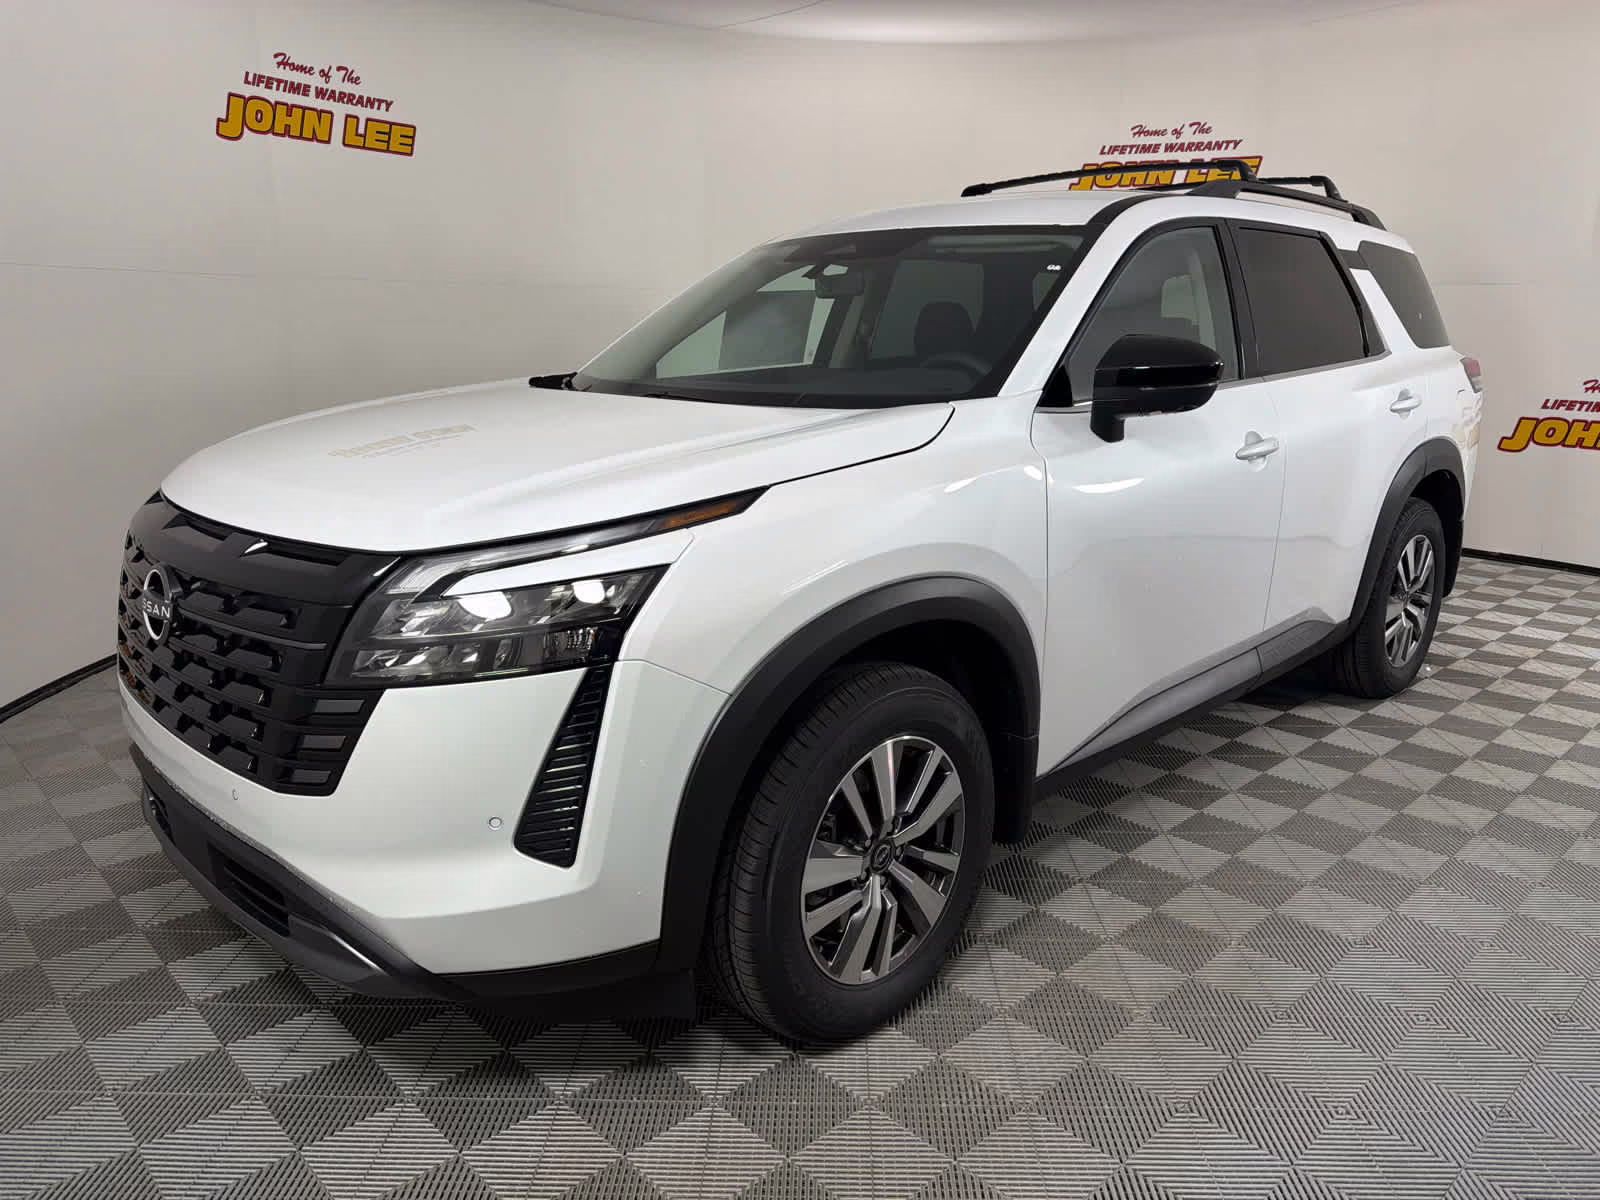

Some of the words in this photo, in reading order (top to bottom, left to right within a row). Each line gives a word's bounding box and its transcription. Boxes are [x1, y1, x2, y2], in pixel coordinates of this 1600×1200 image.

[273, 52, 315, 76] Home
[319, 64, 332, 84] of
[336, 65, 362, 85] The
[243, 71, 312, 97] LIFETIME
[314, 85, 394, 112] WARRANTY
[216, 92, 334, 144] JOHN
[342, 113, 417, 157] LEE
[1130, 124, 1168, 138] Home
[1171, 123, 1185, 139] of
[1188, 121, 1213, 135] The
[1098, 142, 1160, 156] LIFETIME
[1163, 138, 1243, 153] WARRANTY
[1497, 416, 1600, 453] JOH
